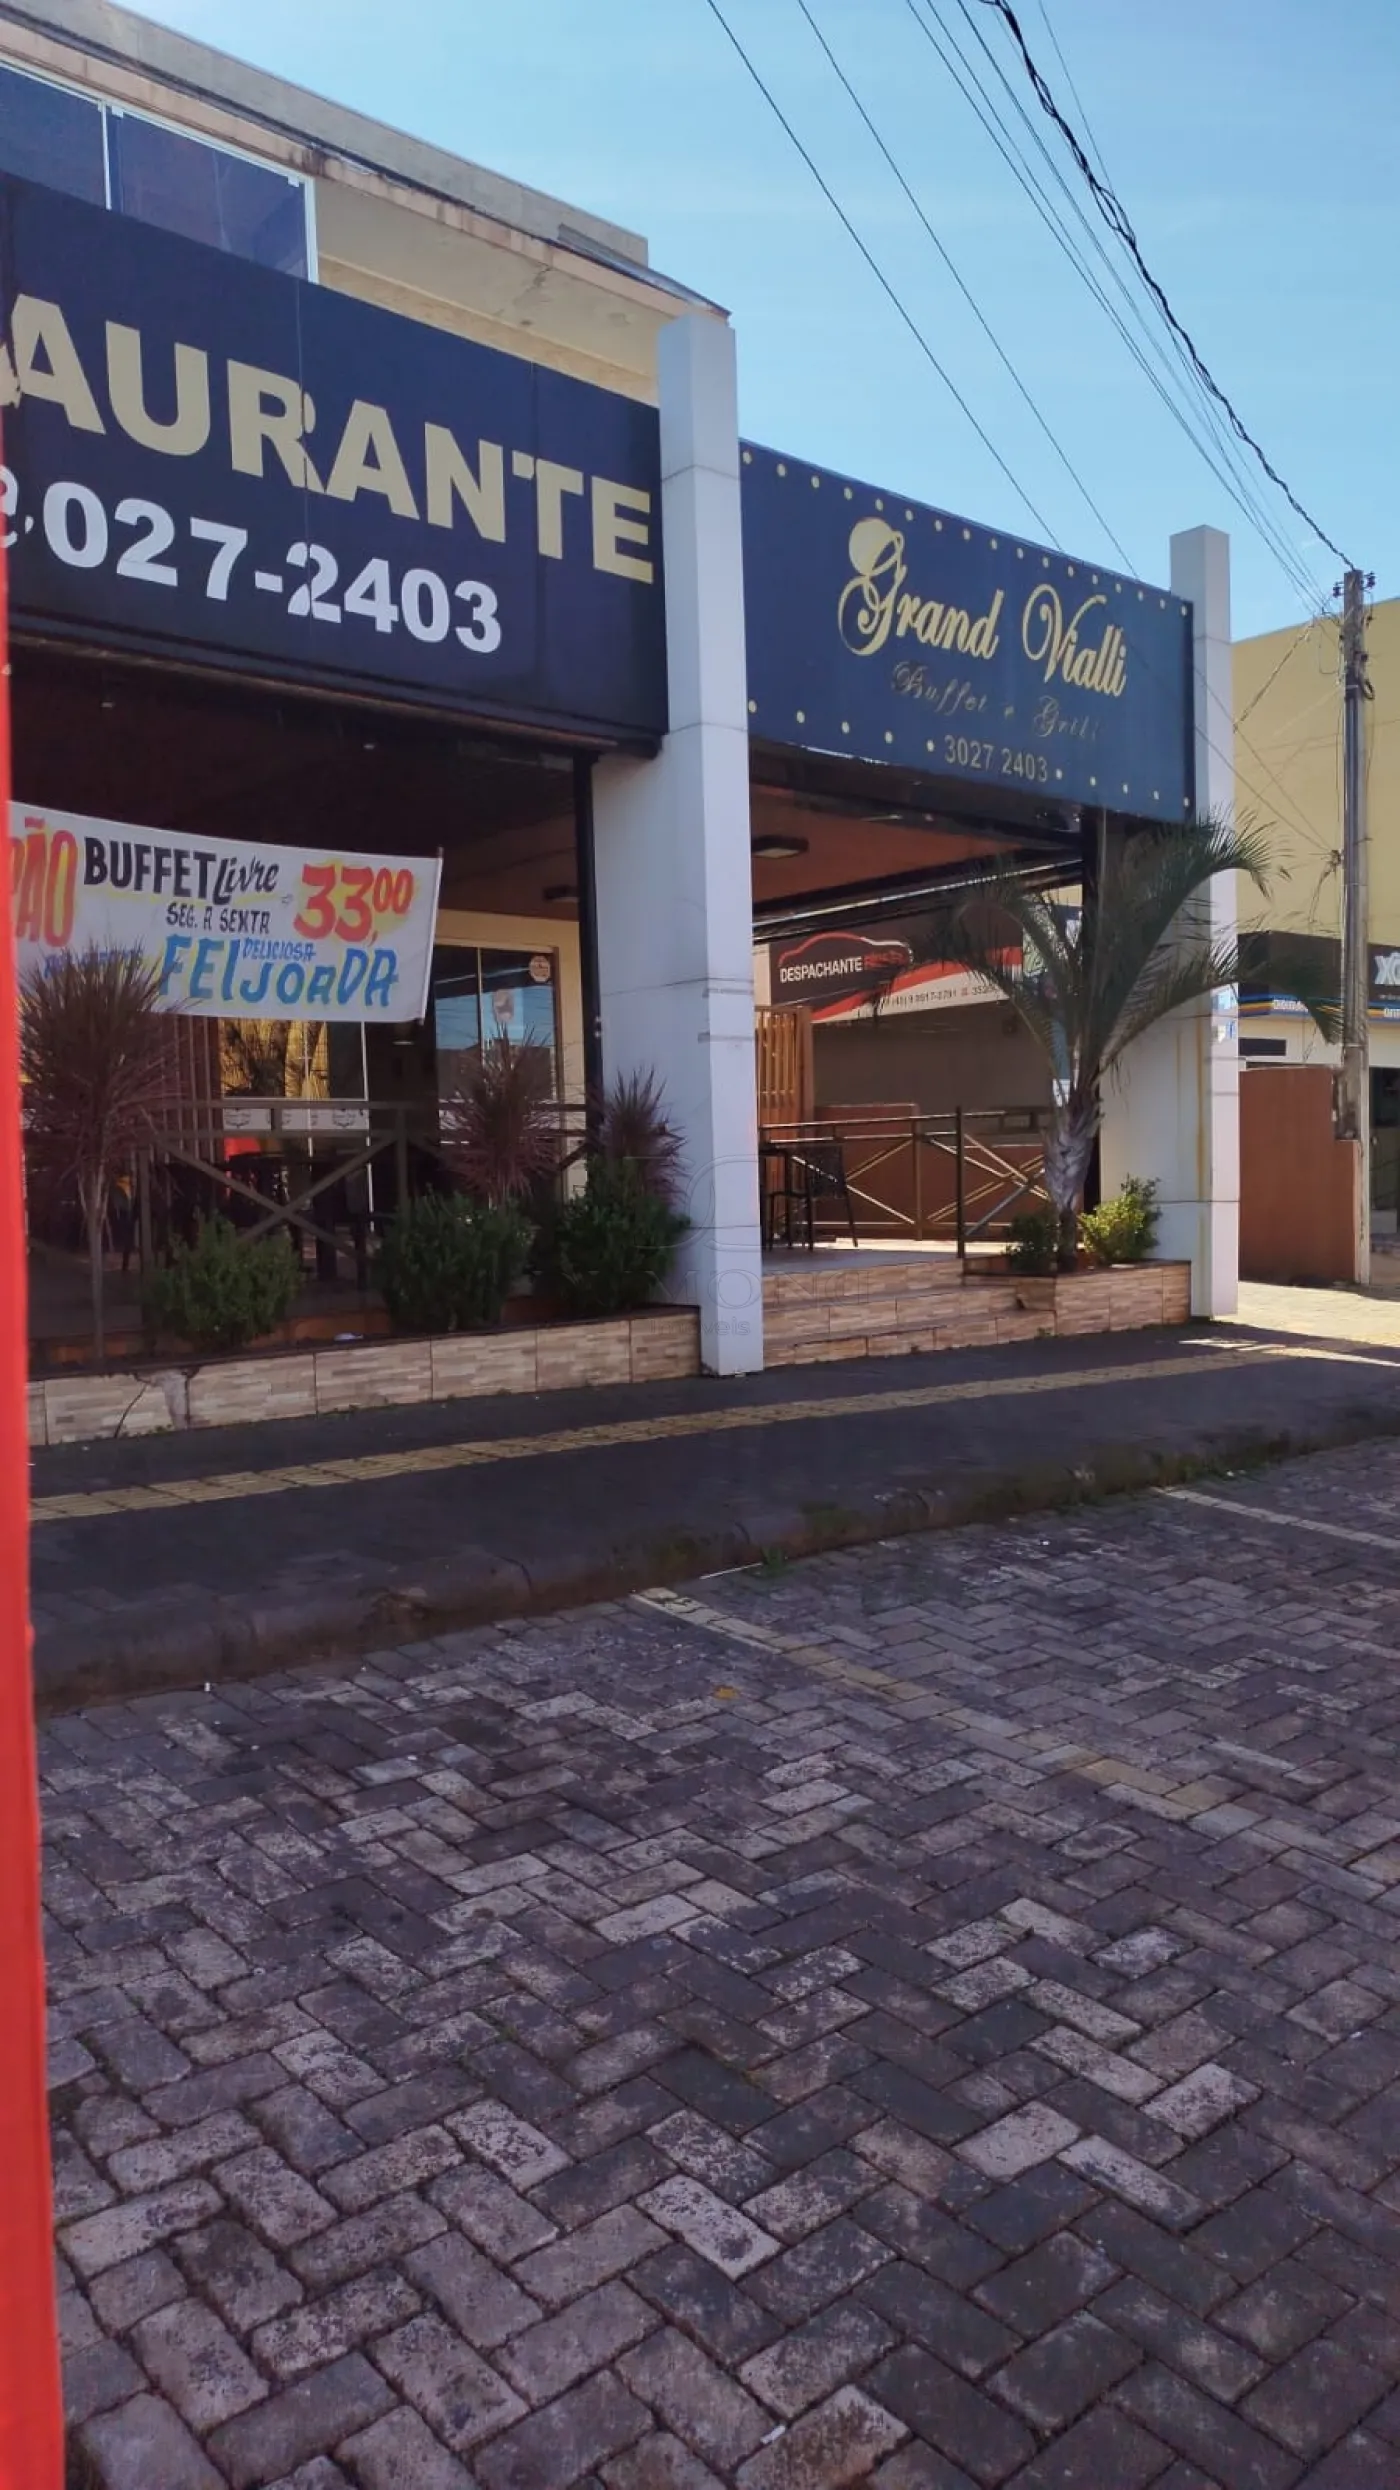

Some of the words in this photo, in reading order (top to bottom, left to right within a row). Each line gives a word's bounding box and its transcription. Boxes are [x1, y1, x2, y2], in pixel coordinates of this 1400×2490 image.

[838, 517, 1003, 660] Grand
[1022, 584, 1126, 698] Vialli
[944, 734, 995, 770] 3027
[1002, 748, 1048, 783] 2403
[83, 835, 218, 900] BUFFET
[213, 853, 281, 906] Livre
[166, 901, 198, 930] SEG.
[219, 908, 271, 934] SEXTA
[159, 933, 400, 1008] FEIJOADA
[241, 936, 317, 962] DELICIOSA
[779, 955, 864, 984] DESPACHANTE
